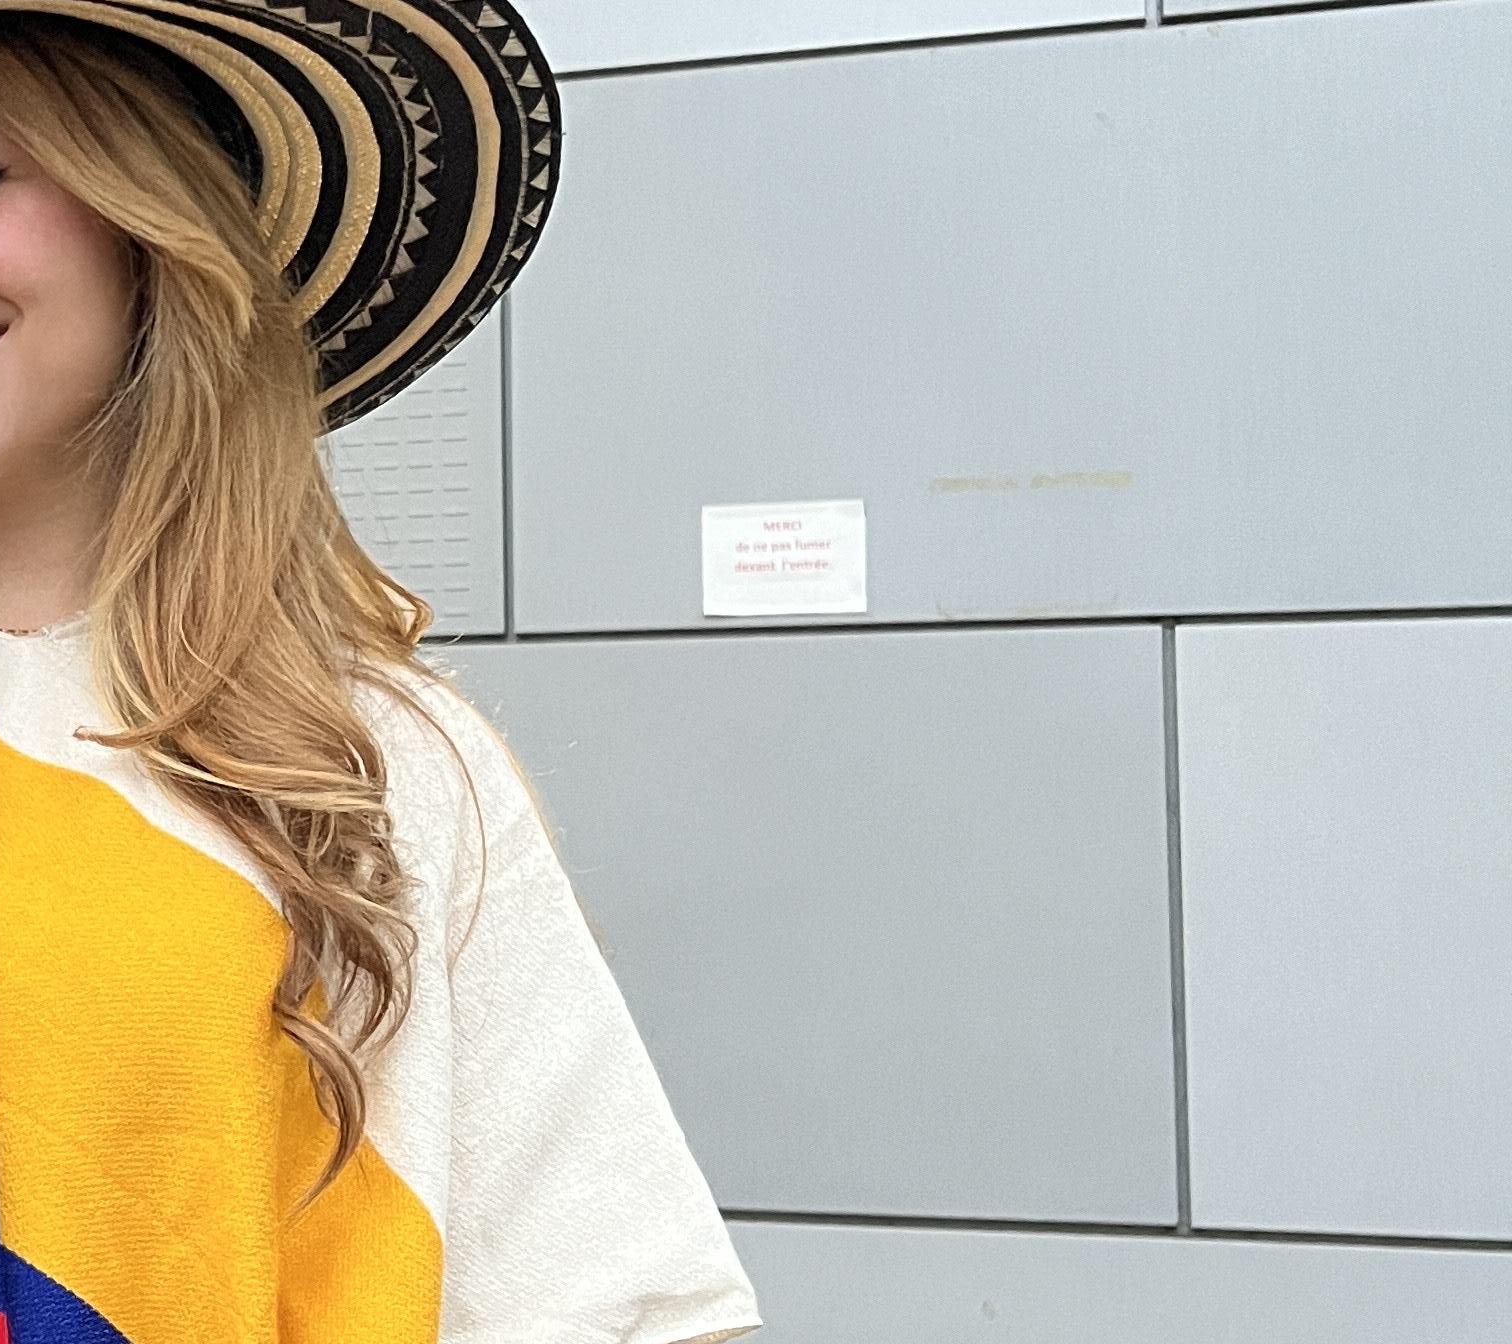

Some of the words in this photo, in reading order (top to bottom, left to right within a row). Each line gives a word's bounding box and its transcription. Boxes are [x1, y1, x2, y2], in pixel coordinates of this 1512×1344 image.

[763, 520, 803, 532] MERCI
[736, 540, 750, 553] de
[771, 542, 792, 554] pas
[795, 538, 832, 551] fumer
[734, 561, 777, 574] devant
